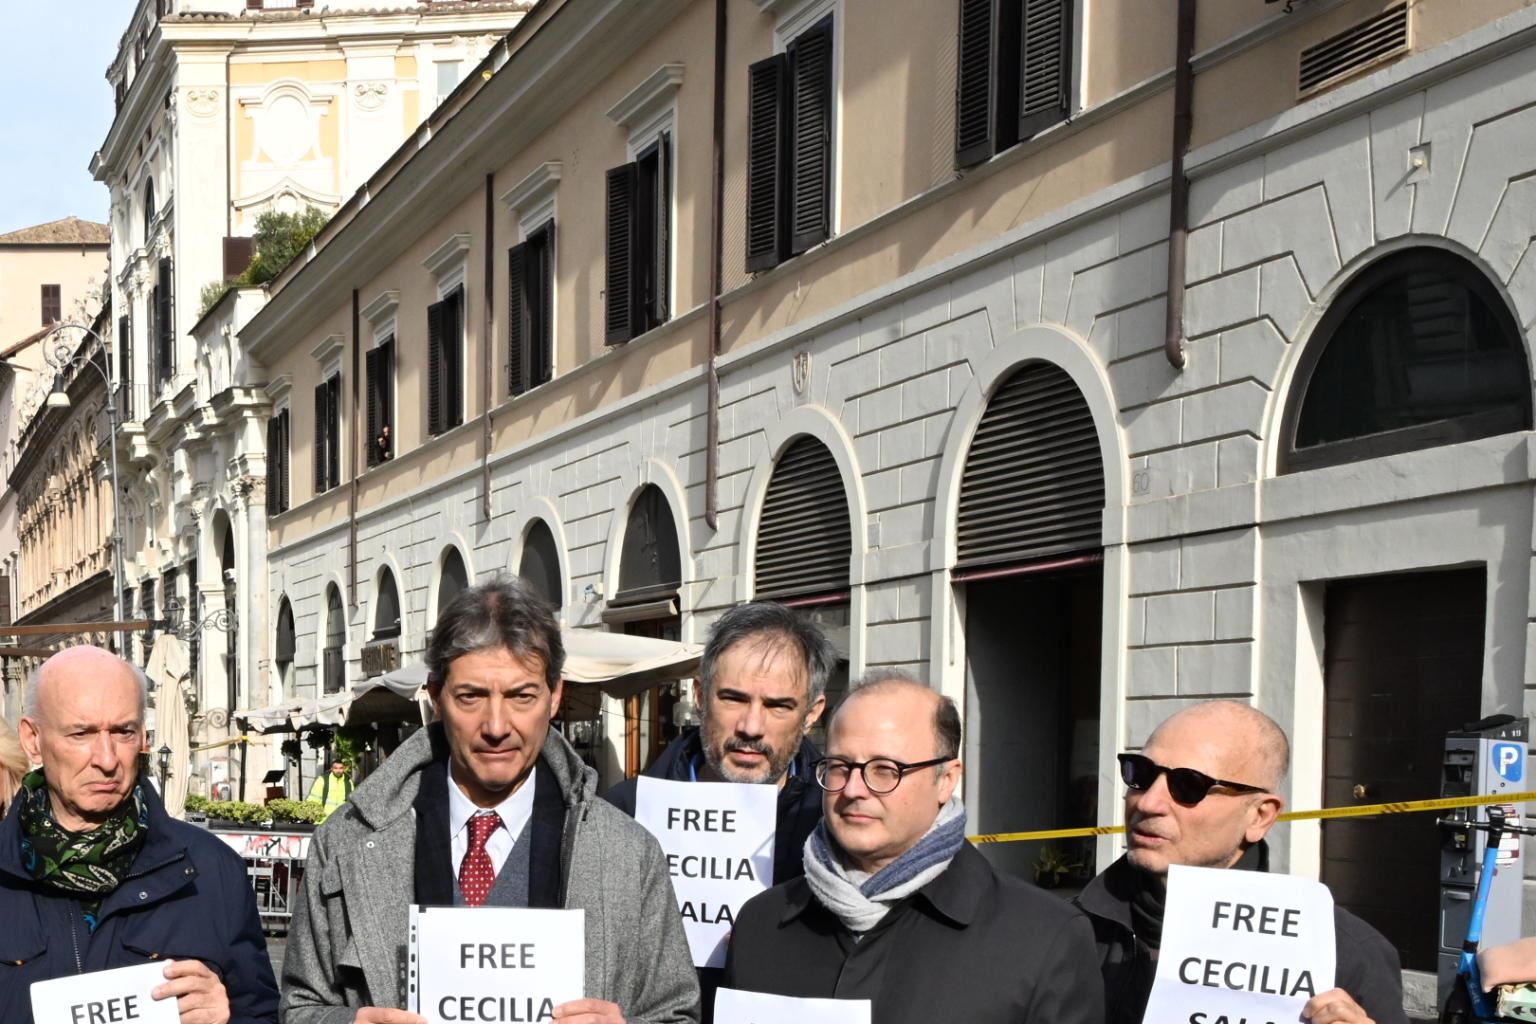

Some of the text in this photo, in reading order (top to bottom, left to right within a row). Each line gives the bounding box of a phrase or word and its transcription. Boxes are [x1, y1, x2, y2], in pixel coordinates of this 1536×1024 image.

[1500, 746, 1519, 776] P
[667, 807, 737, 833] FREE
[666, 853, 755, 881] ECILIA
[680, 901, 735, 926] ALA
[1212, 901, 1301, 938] FREE
[460, 943, 535, 969] FREE
[1178, 956, 1316, 999] CECILIA
[438, 997, 556, 1023] CECILIA
